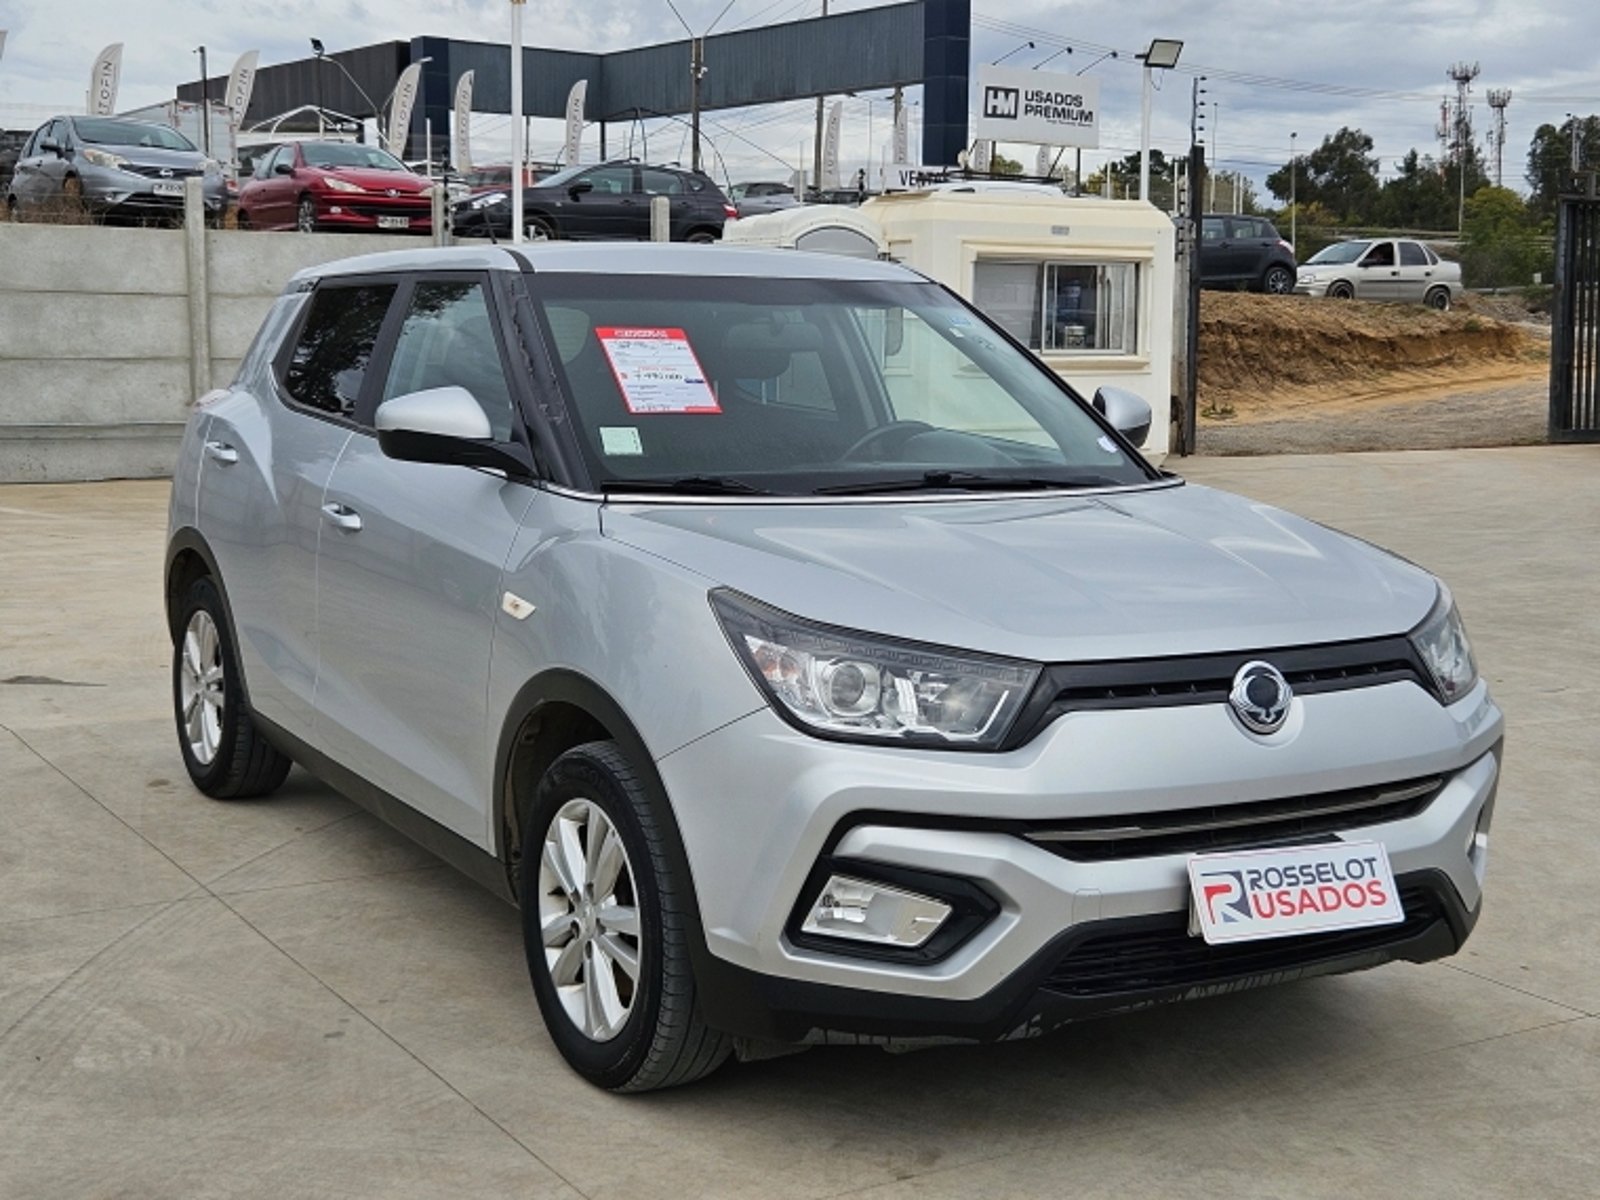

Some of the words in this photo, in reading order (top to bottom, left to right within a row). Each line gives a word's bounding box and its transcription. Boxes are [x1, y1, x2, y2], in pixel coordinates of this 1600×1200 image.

[986, 88, 1018, 118] HM
[1024, 89, 1083, 108] USADOS
[1024, 103, 1094, 123] PREMIUM
[1247, 857, 1378, 891] ROSSELOT
[1253, 880, 1387, 919] USADOS
